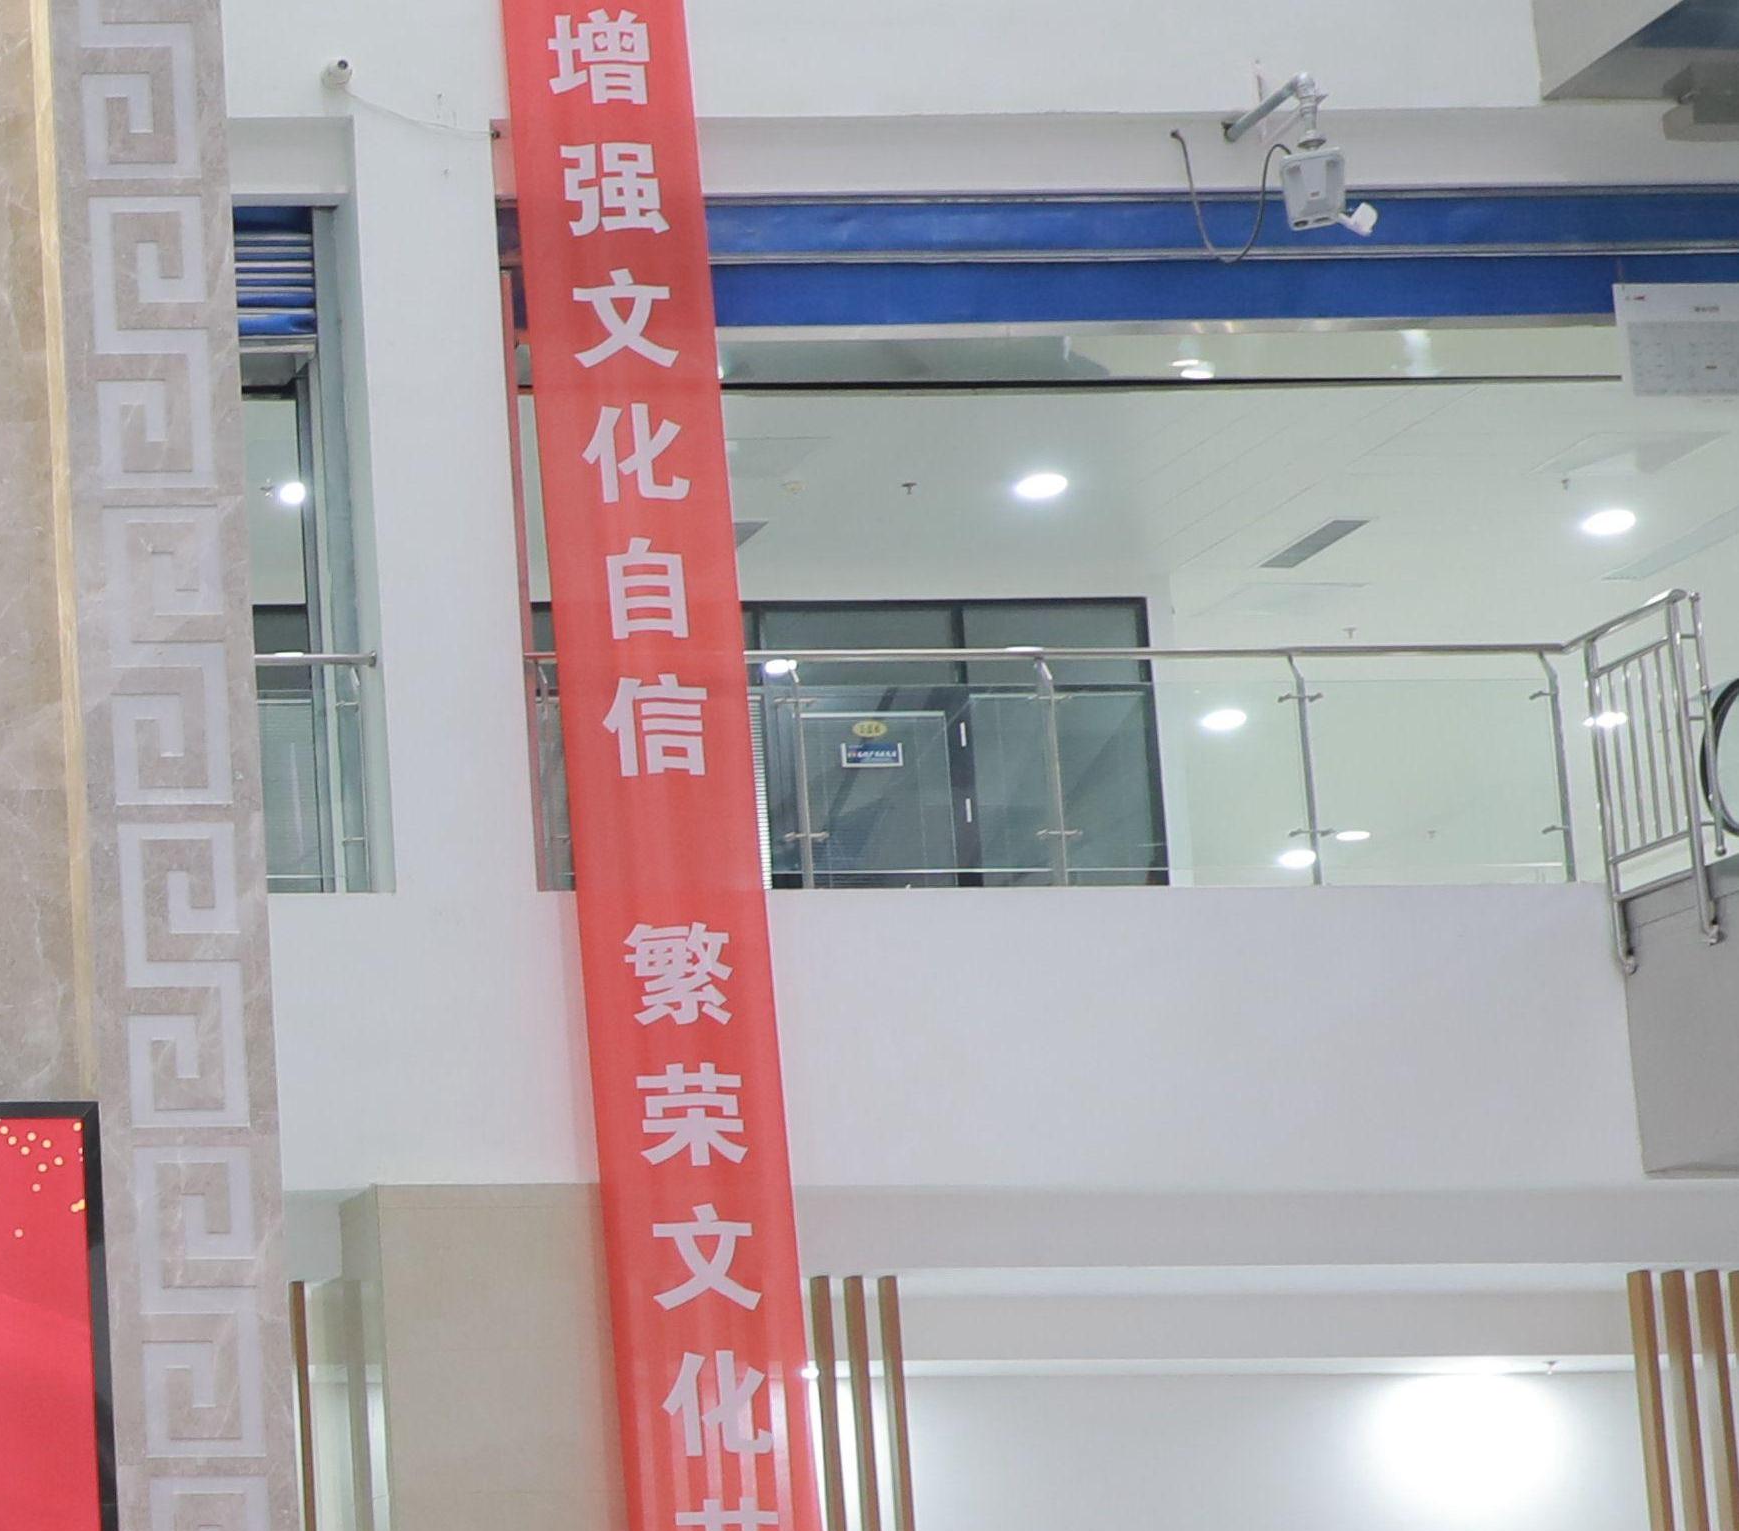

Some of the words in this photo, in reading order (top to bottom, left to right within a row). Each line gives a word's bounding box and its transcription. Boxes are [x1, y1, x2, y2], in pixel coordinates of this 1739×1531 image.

[547, 9, 709, 778] 增强文化自信
